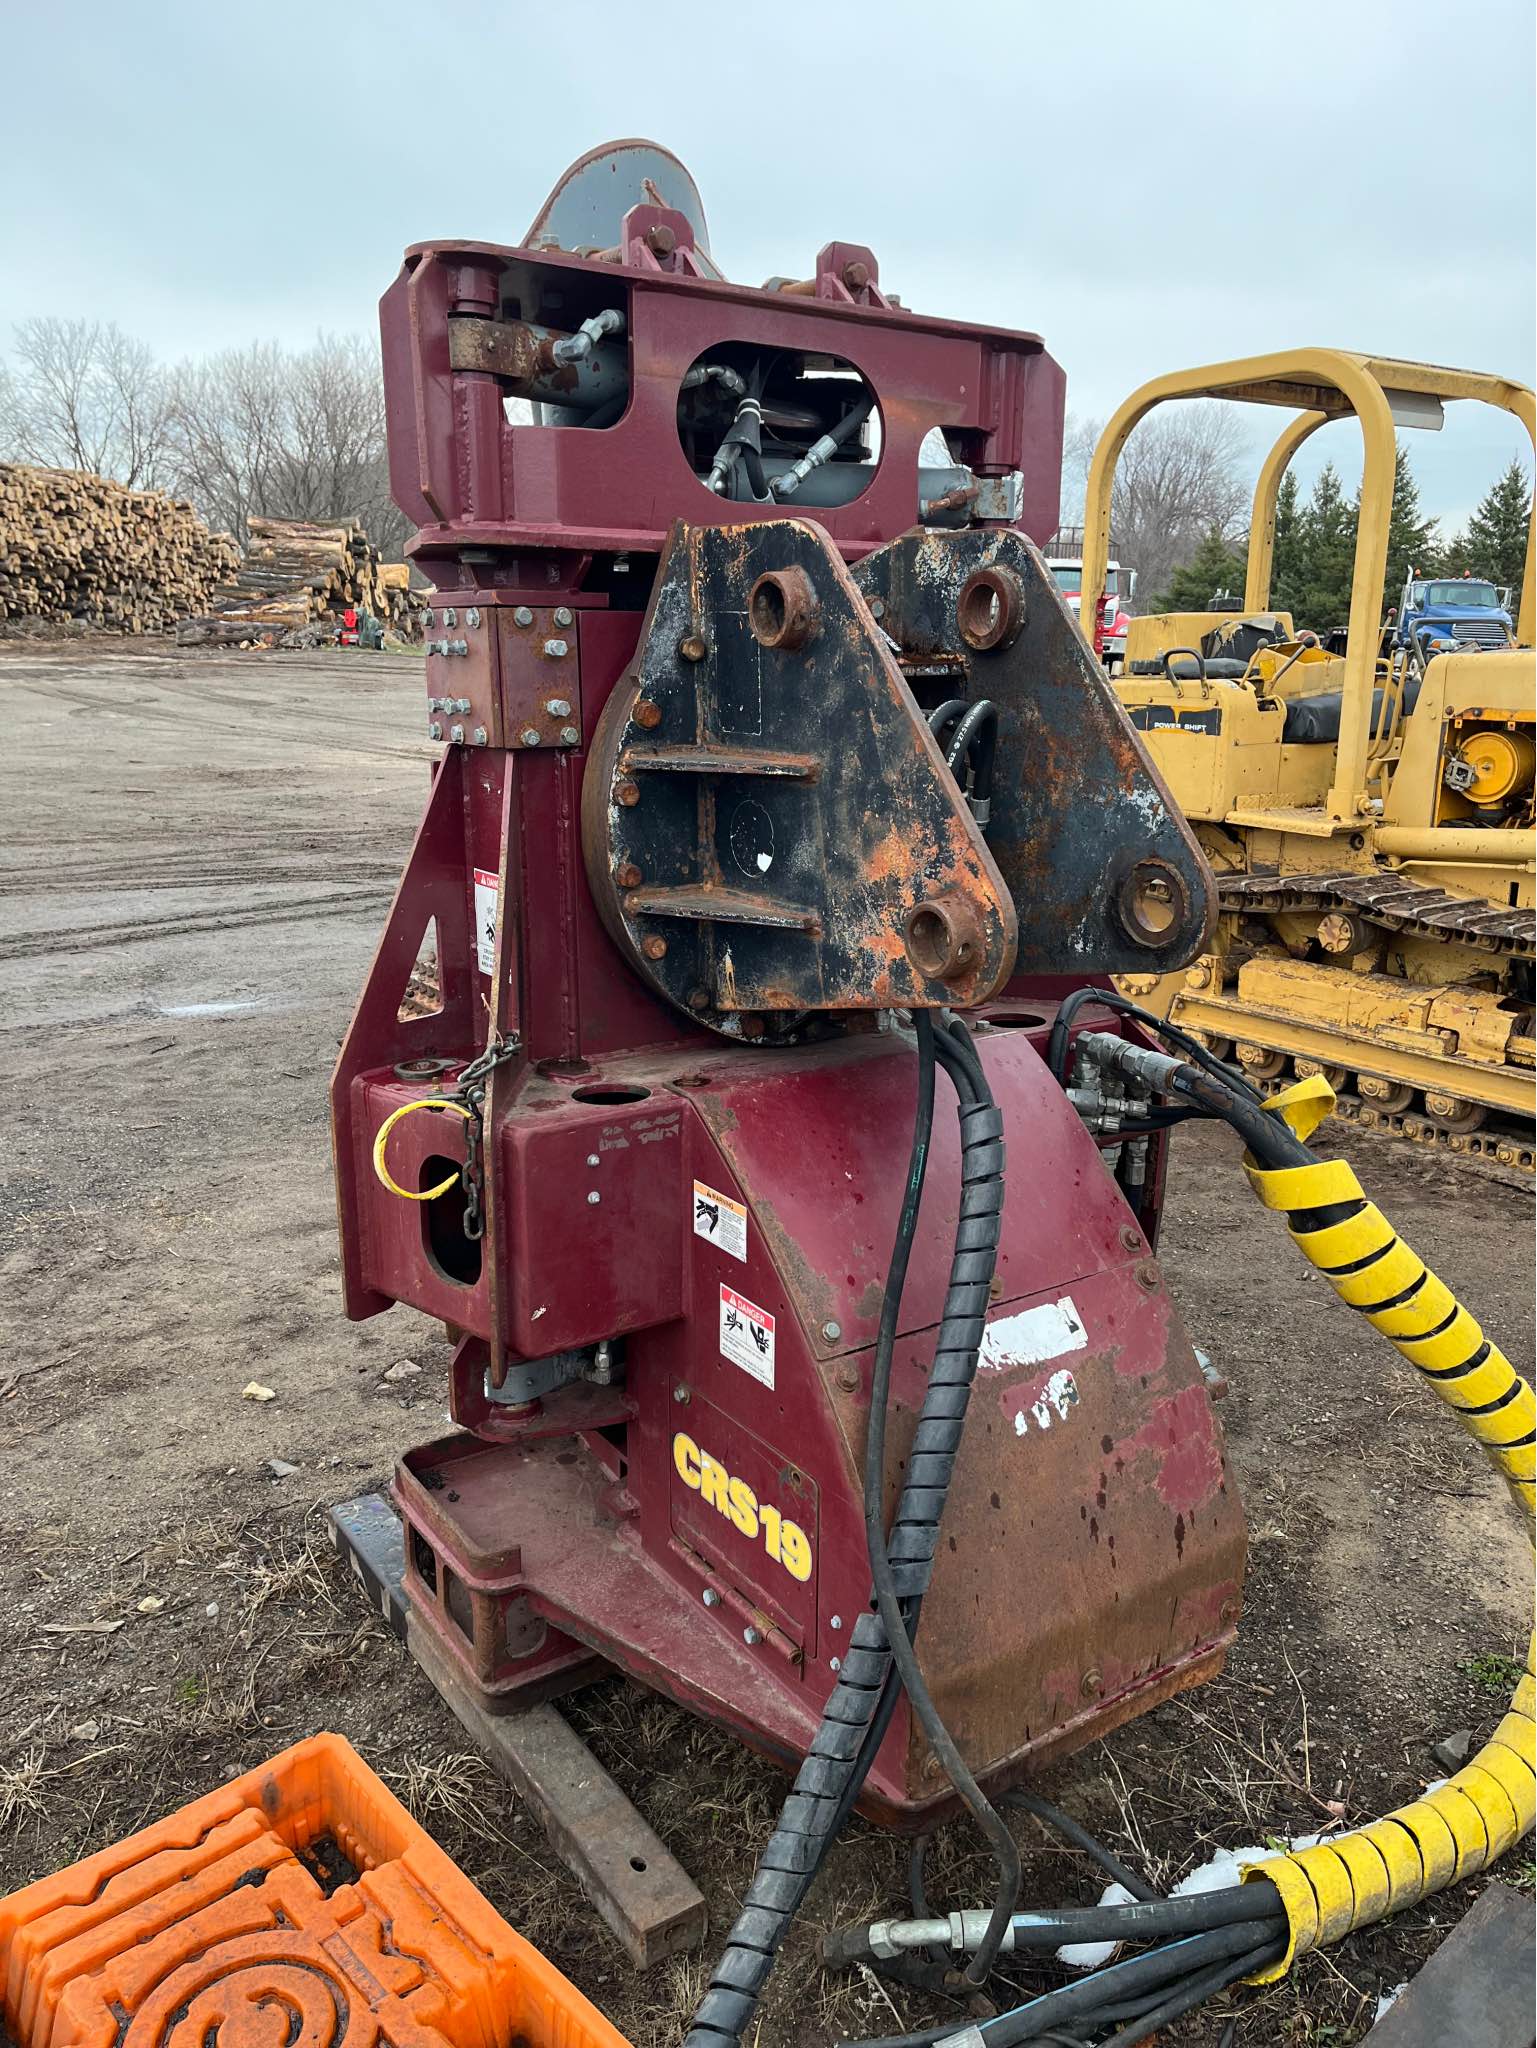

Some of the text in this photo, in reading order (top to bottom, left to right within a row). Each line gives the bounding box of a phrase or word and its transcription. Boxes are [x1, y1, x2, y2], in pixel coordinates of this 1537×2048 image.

[1154, 721, 1207, 732] POWER SHIFT
[710, 1192, 734, 1210] WARNING
[737, 1300, 765, 1325] DANGER
[673, 1432, 813, 1582] CRS19
